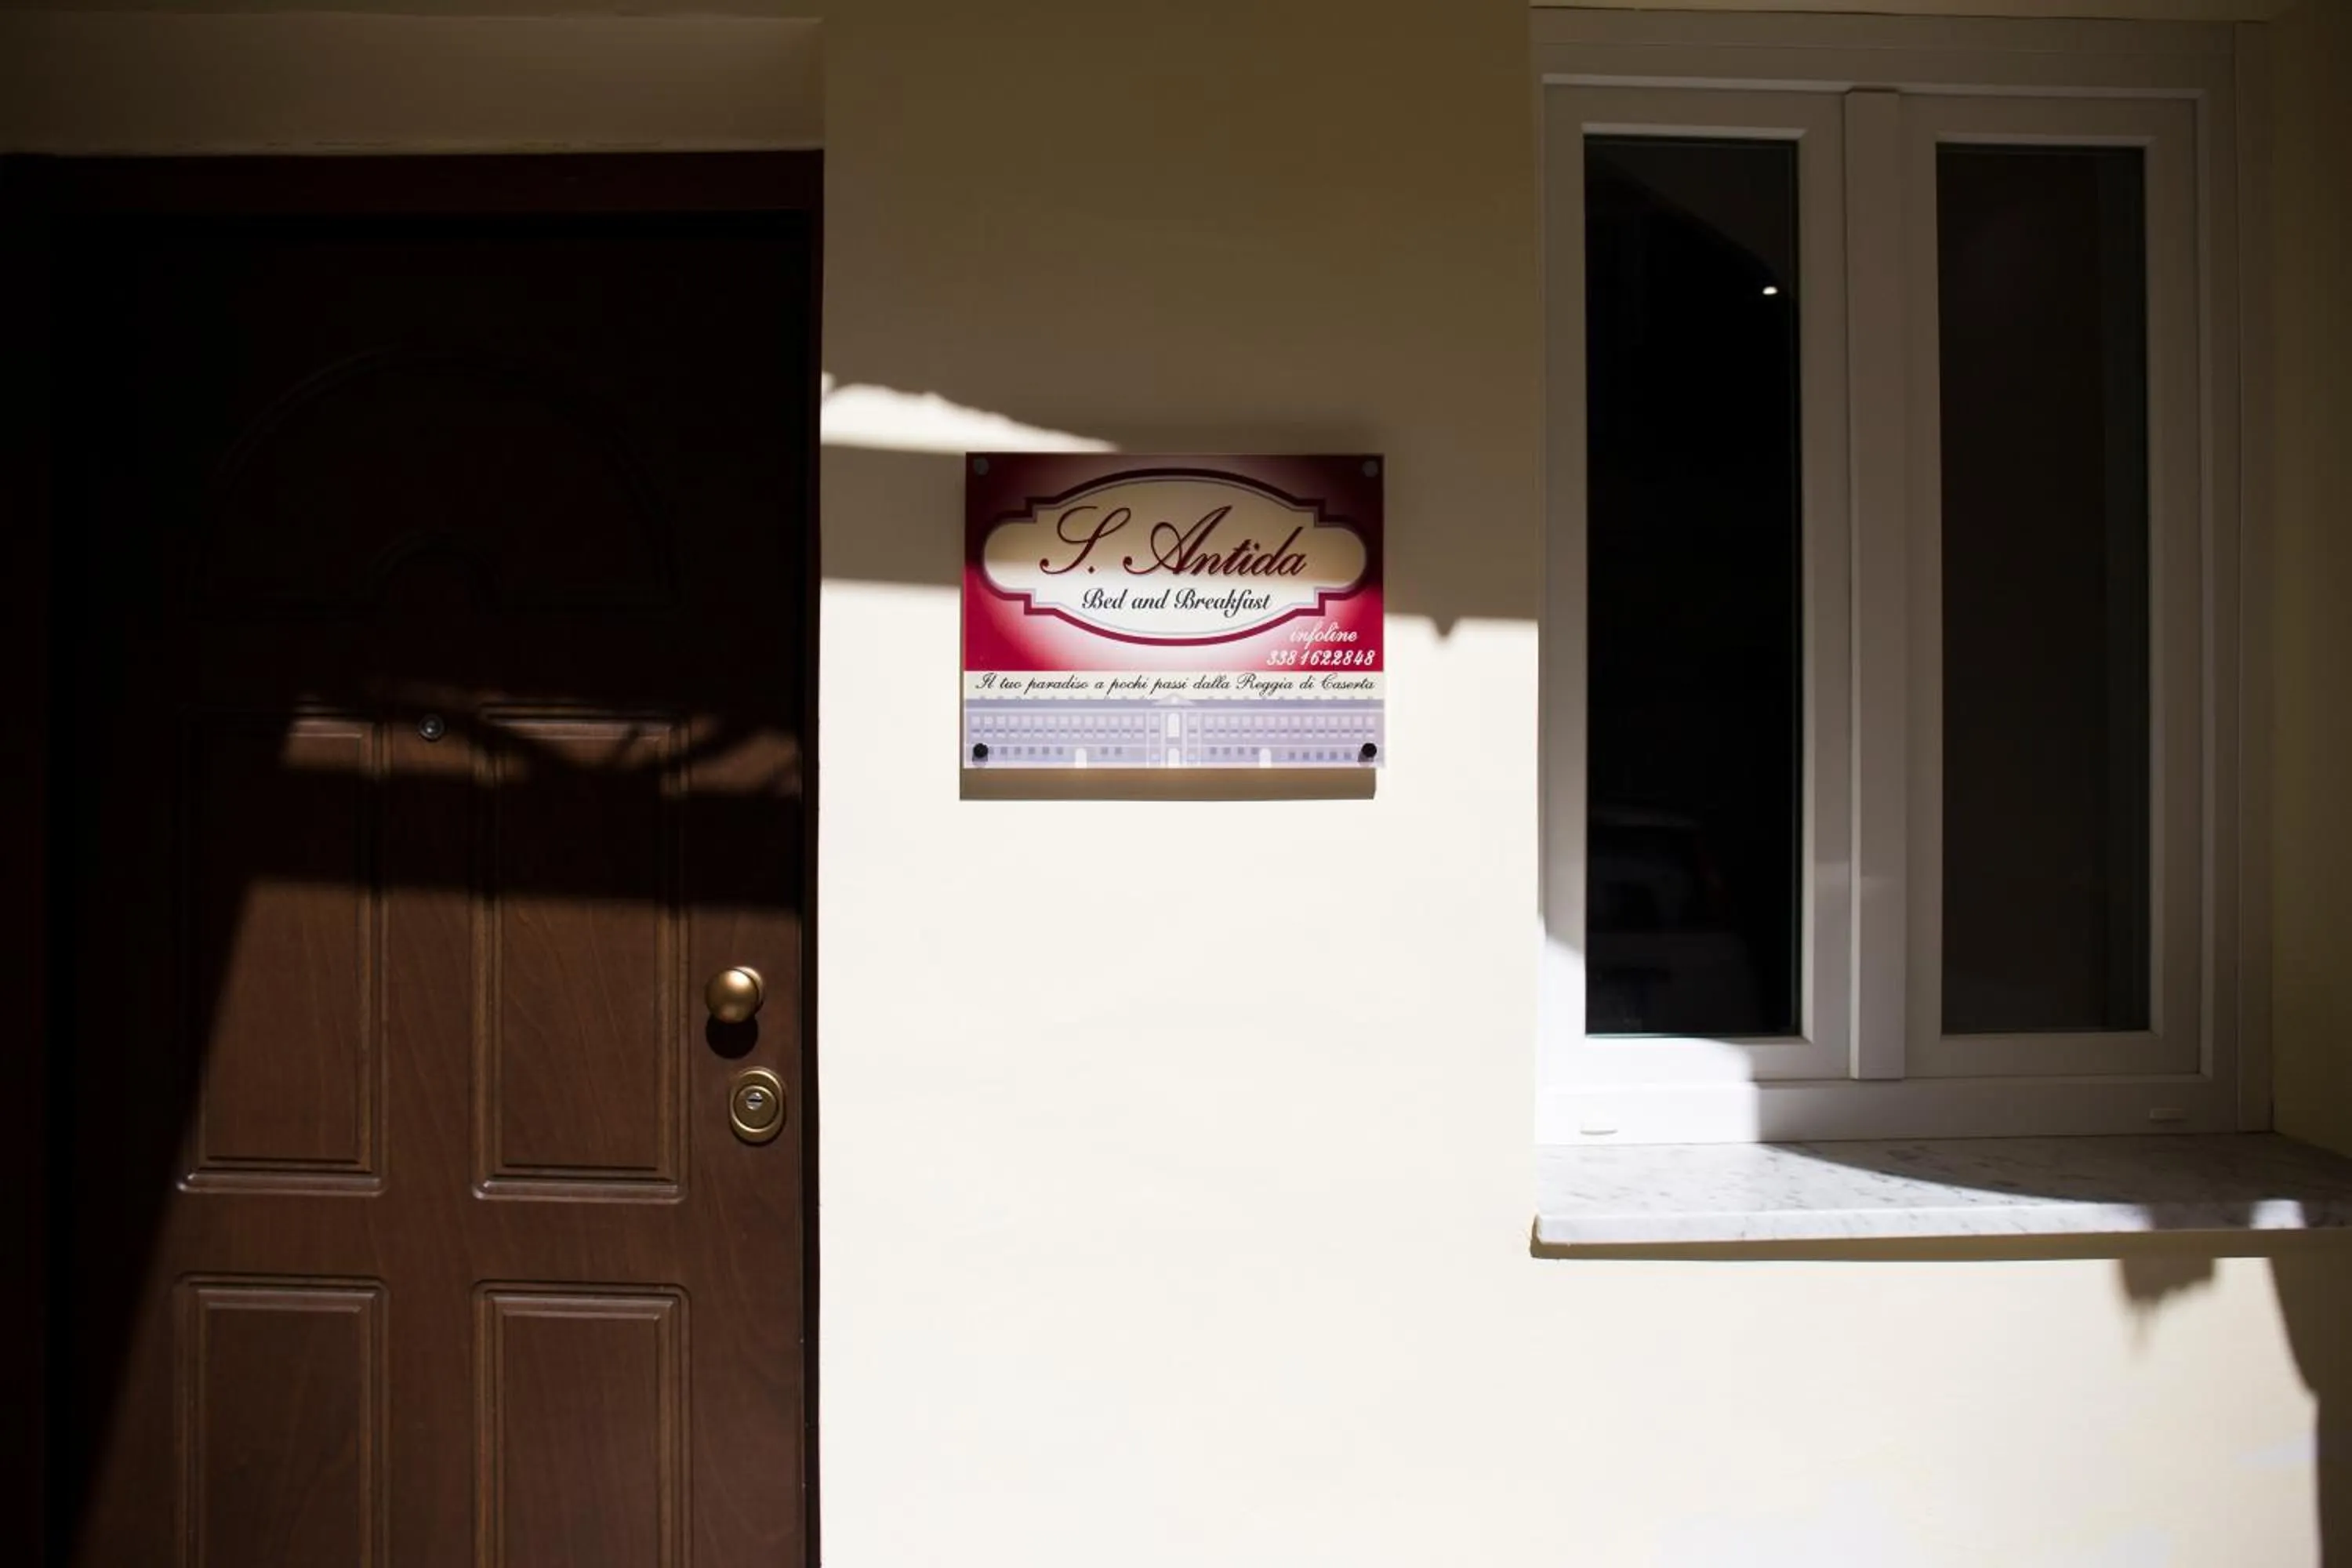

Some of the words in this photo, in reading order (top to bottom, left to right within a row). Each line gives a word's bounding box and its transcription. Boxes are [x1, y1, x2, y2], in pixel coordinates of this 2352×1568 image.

[1040, 506, 1131, 575] S.
[1123, 506, 1308, 576] Antida
[1082, 588, 1128, 609] Bed
[1131, 589, 1171, 609] and
[1174, 588, 1270, 618] Breakfast
[1290, 621, 1358, 650] infoline
[975, 672, 995, 689] Il
[1000, 677, 1022, 689] tuo
[1023, 674, 1087, 695] paradiso
[1106, 674, 1148, 695] pochi
[1149, 677, 1189, 695] passi
[1192, 674, 1230, 689] dalla
[1235, 673, 1294, 696] Reggia
[1299, 674, 1314, 689] di
[1321, 673, 1375, 689] Caserta
